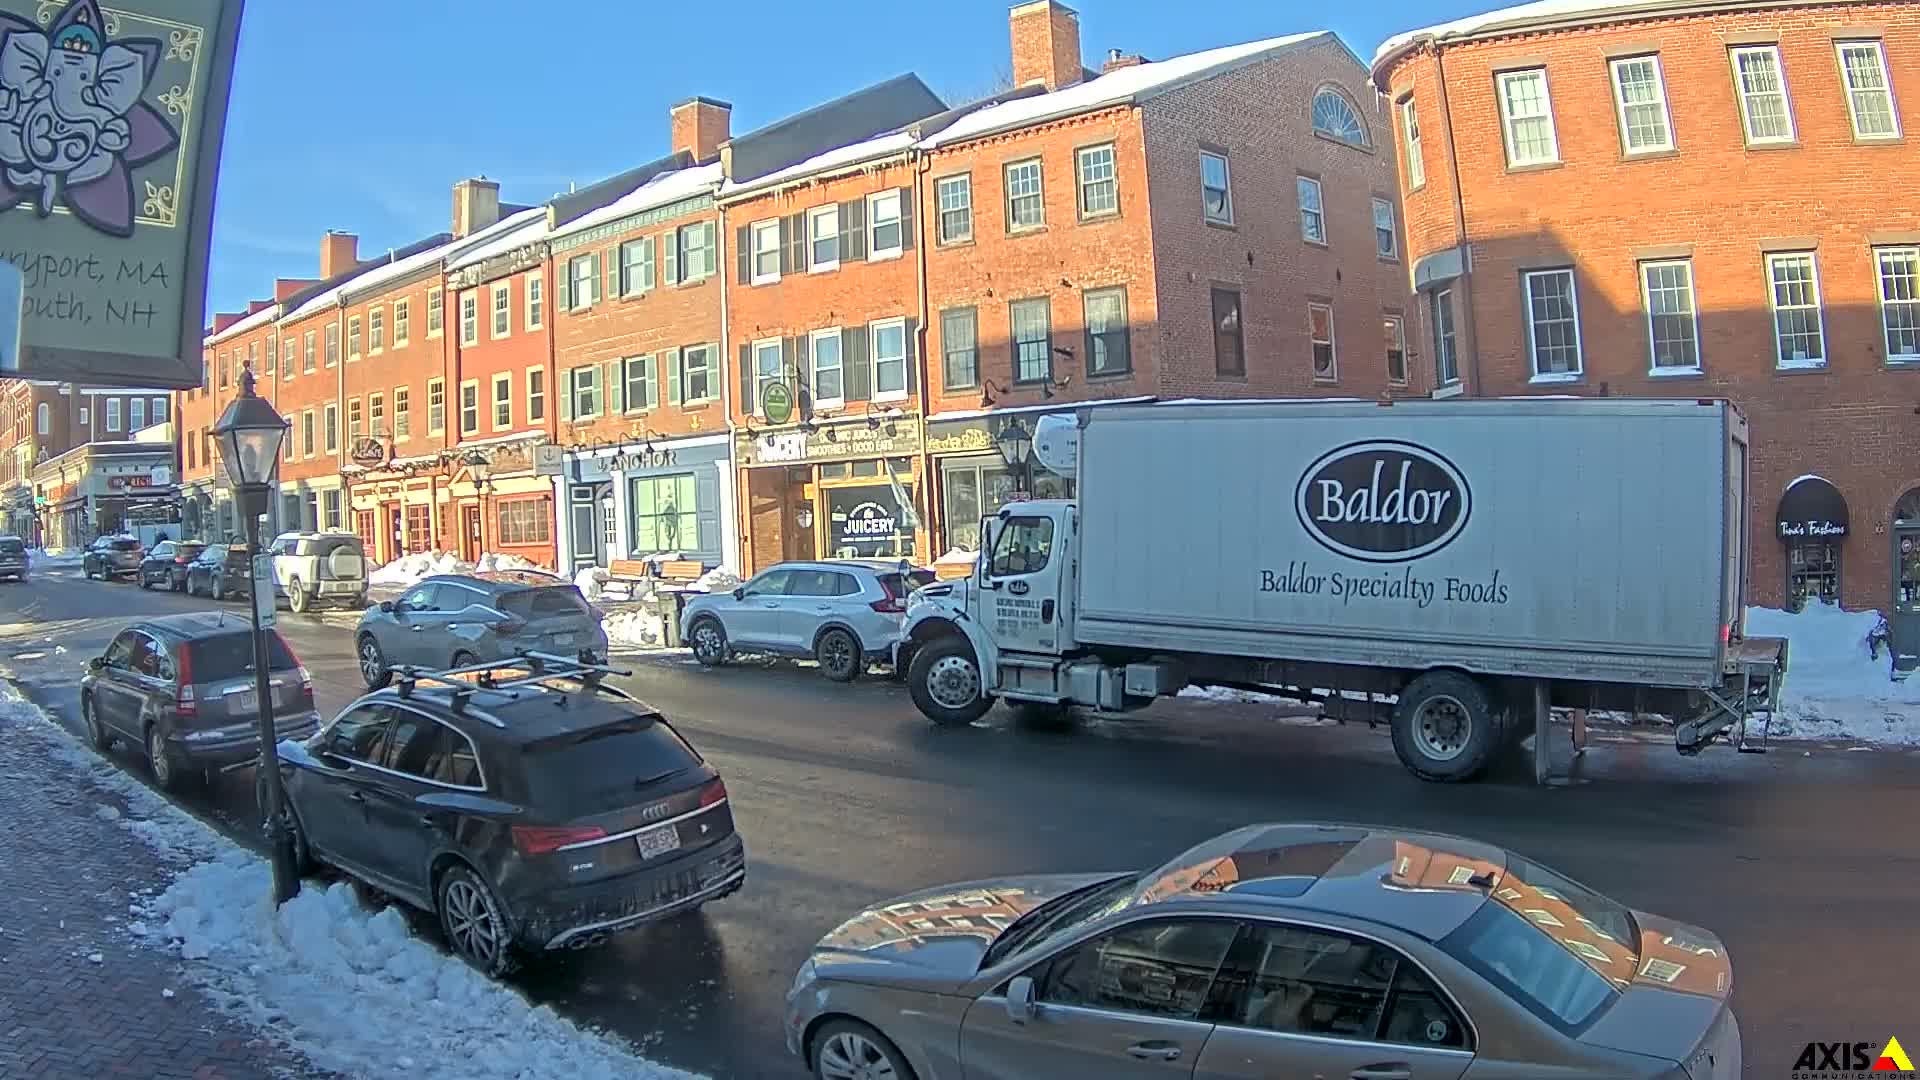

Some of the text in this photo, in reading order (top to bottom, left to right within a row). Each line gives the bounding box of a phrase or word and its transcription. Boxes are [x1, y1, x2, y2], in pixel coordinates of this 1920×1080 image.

[0, 250, 169, 289] ryport, MA
[105, 299, 160, 328] NH
[611, 450, 677, 471] ANCHOR
[1317, 459, 1452, 525] Baldor
[843, 517, 895, 535] JUICERY
[1780, 520, 1845, 536] Tina's Fashions
[1260, 561, 1509, 608] Baldor Specialty Foods
